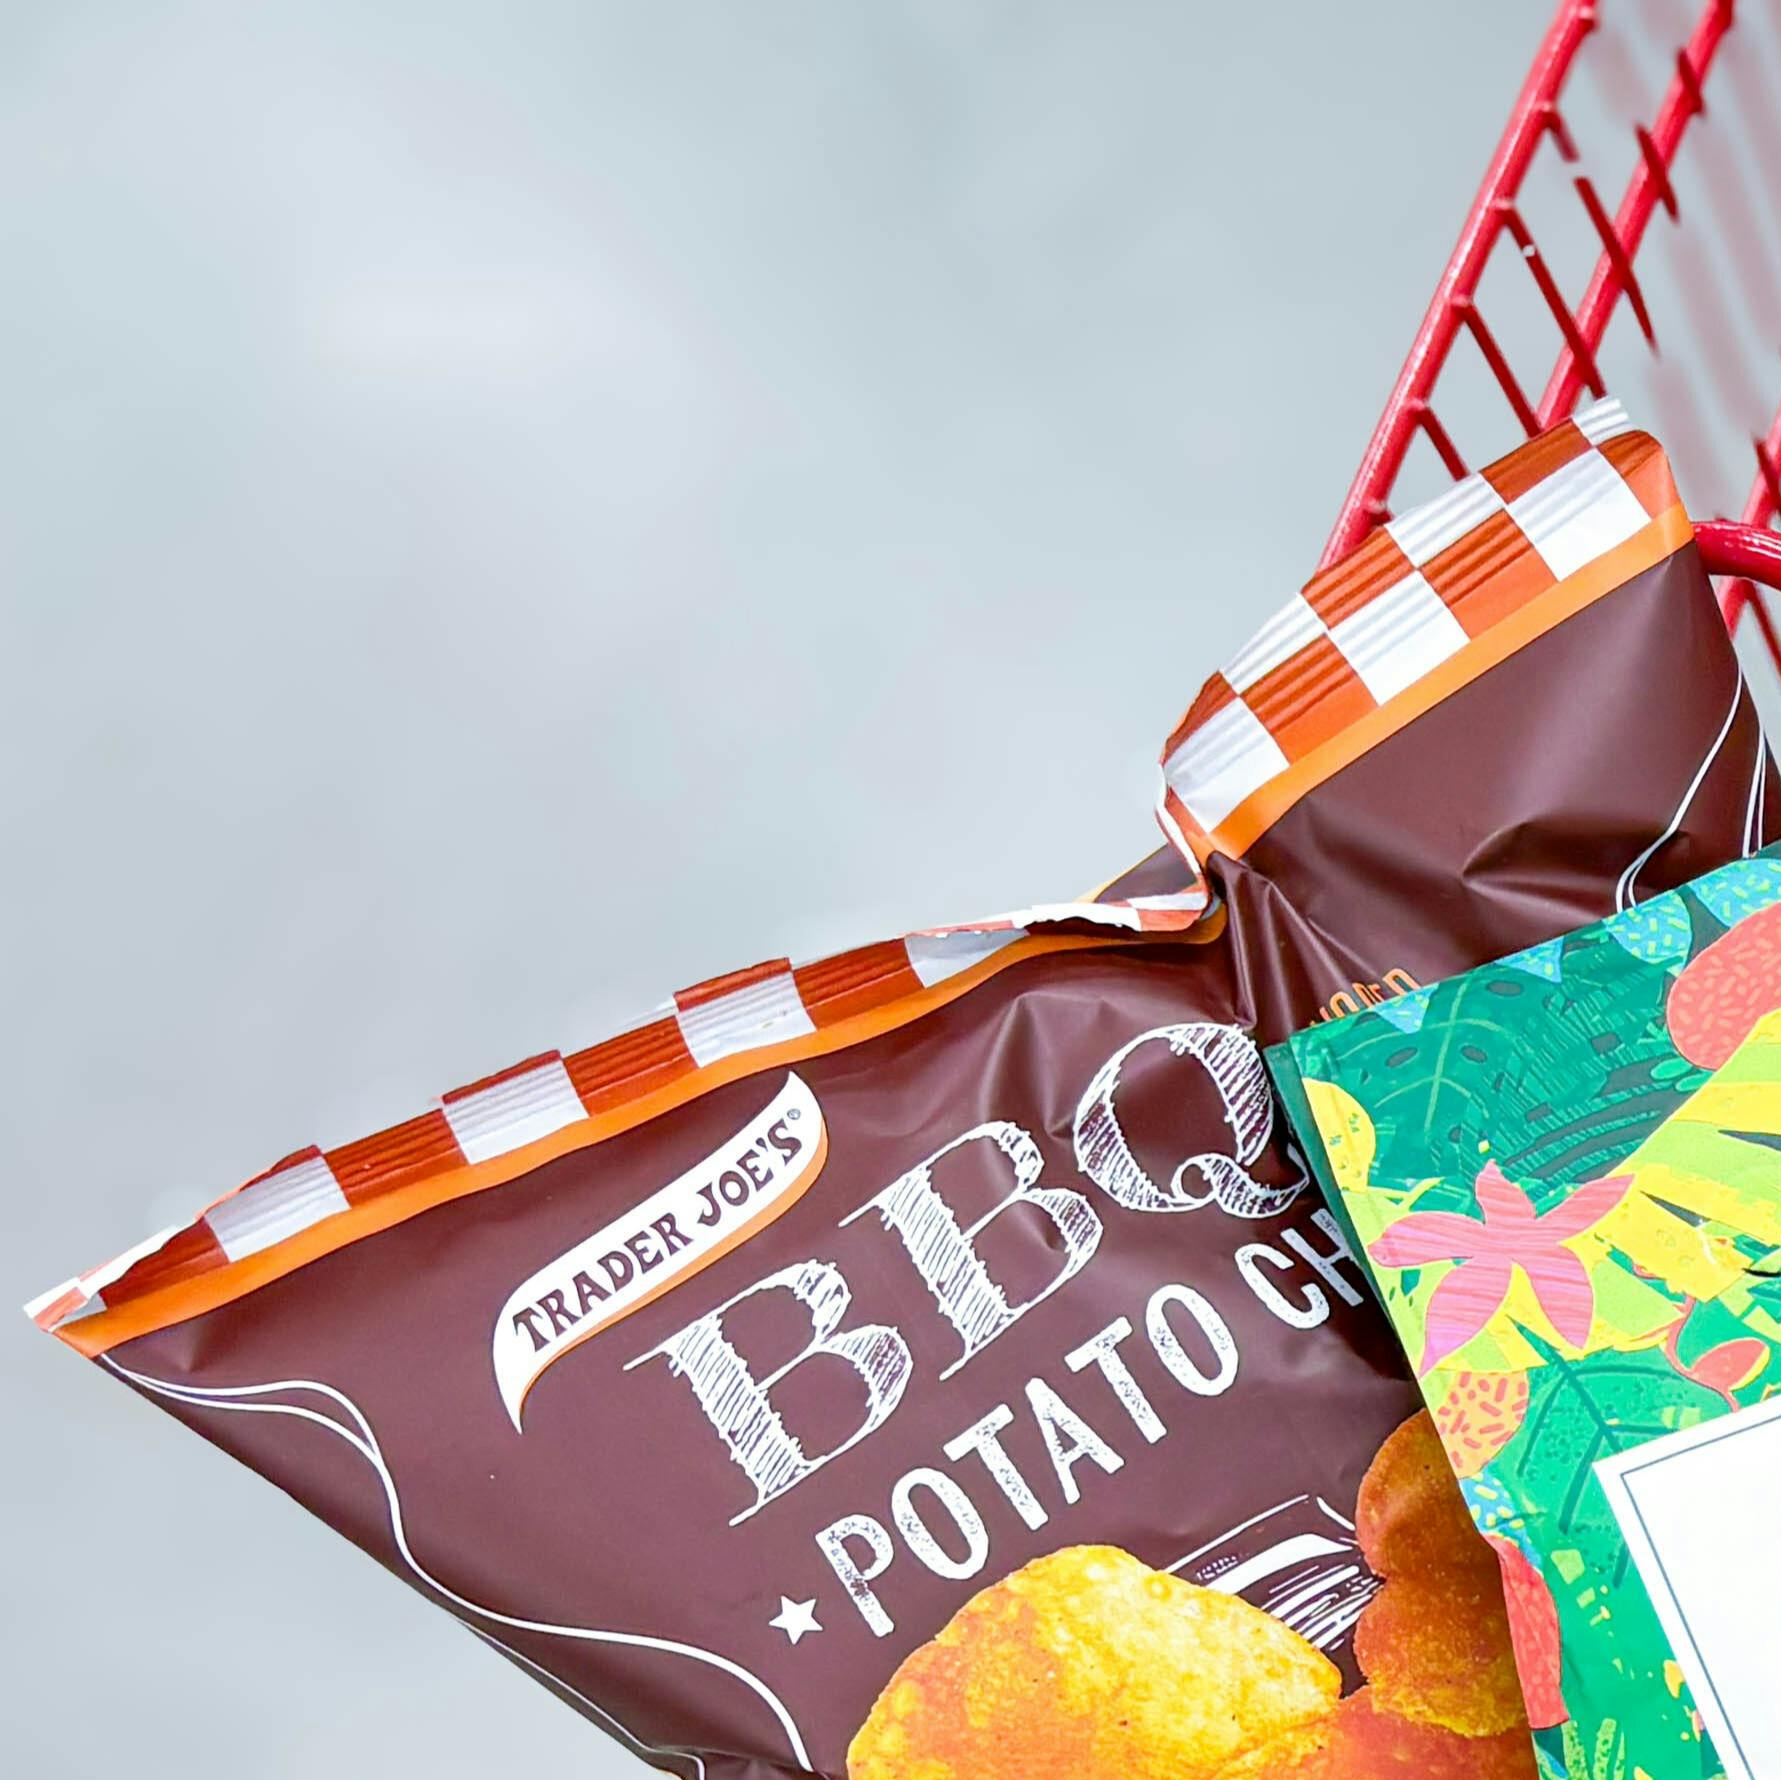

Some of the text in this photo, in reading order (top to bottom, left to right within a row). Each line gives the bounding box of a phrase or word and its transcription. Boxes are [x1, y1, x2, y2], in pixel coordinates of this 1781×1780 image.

[512, 1212, 695, 1353] TRADER
[623, 1022, 1309, 1527] BBQ
[814, 1282, 1239, 1638] POTATO
